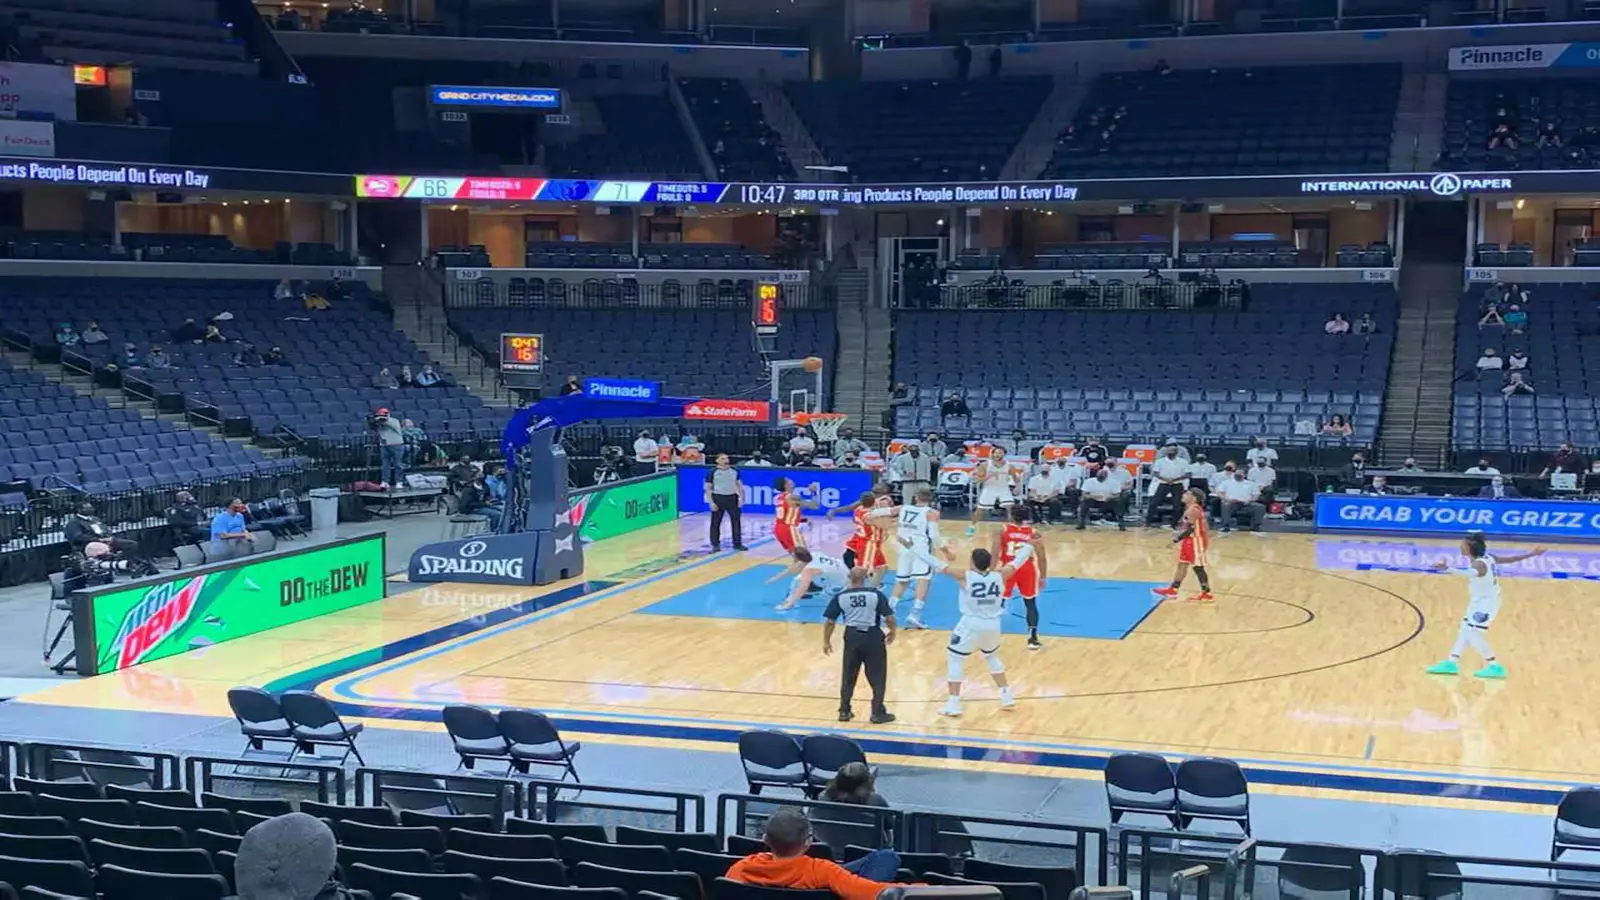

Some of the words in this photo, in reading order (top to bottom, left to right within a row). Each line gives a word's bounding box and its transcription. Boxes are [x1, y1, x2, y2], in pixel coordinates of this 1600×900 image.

[1461, 48, 1543, 64] Pinnacle
[30, 163, 75, 182] People
[78, 165, 125, 183] Depend
[128, 170, 146, 183] On
[150, 168, 182, 187] Every
[185, 170, 209, 188] Day
[424, 180, 448, 197] 66
[614, 183, 629, 200] 71
[864, 187, 912, 202] Products
[914, 187, 953, 202] People
[955, 186, 999, 202] Depend
[1001, 186, 1017, 200] On
[1020, 185, 1052, 200] Every
[1054, 185, 1078, 200] Day
[1301, 179, 1429, 192] INTERNATIONAL
[1462, 178, 1512, 189] PAPER
[741, 185, 786, 203] 10:47
[793, 189, 816, 201] 3RD
[818, 189, 839, 201] QTR
[590, 381, 651, 399] Pinnacle
[902, 511, 920, 523] 17
[1340, 504, 1412, 523] GRAB
[1420, 506, 1494, 525] YOUR
[1501, 509, 1586, 528] GRIZZ
[419, 555, 524, 579] SPALDING
[280, 577, 305, 607] DO
[305, 577, 331, 600] THE
[330, 563, 369, 594] DEW
[971, 582, 1001, 598] 24
[849, 595, 867, 608] 38
